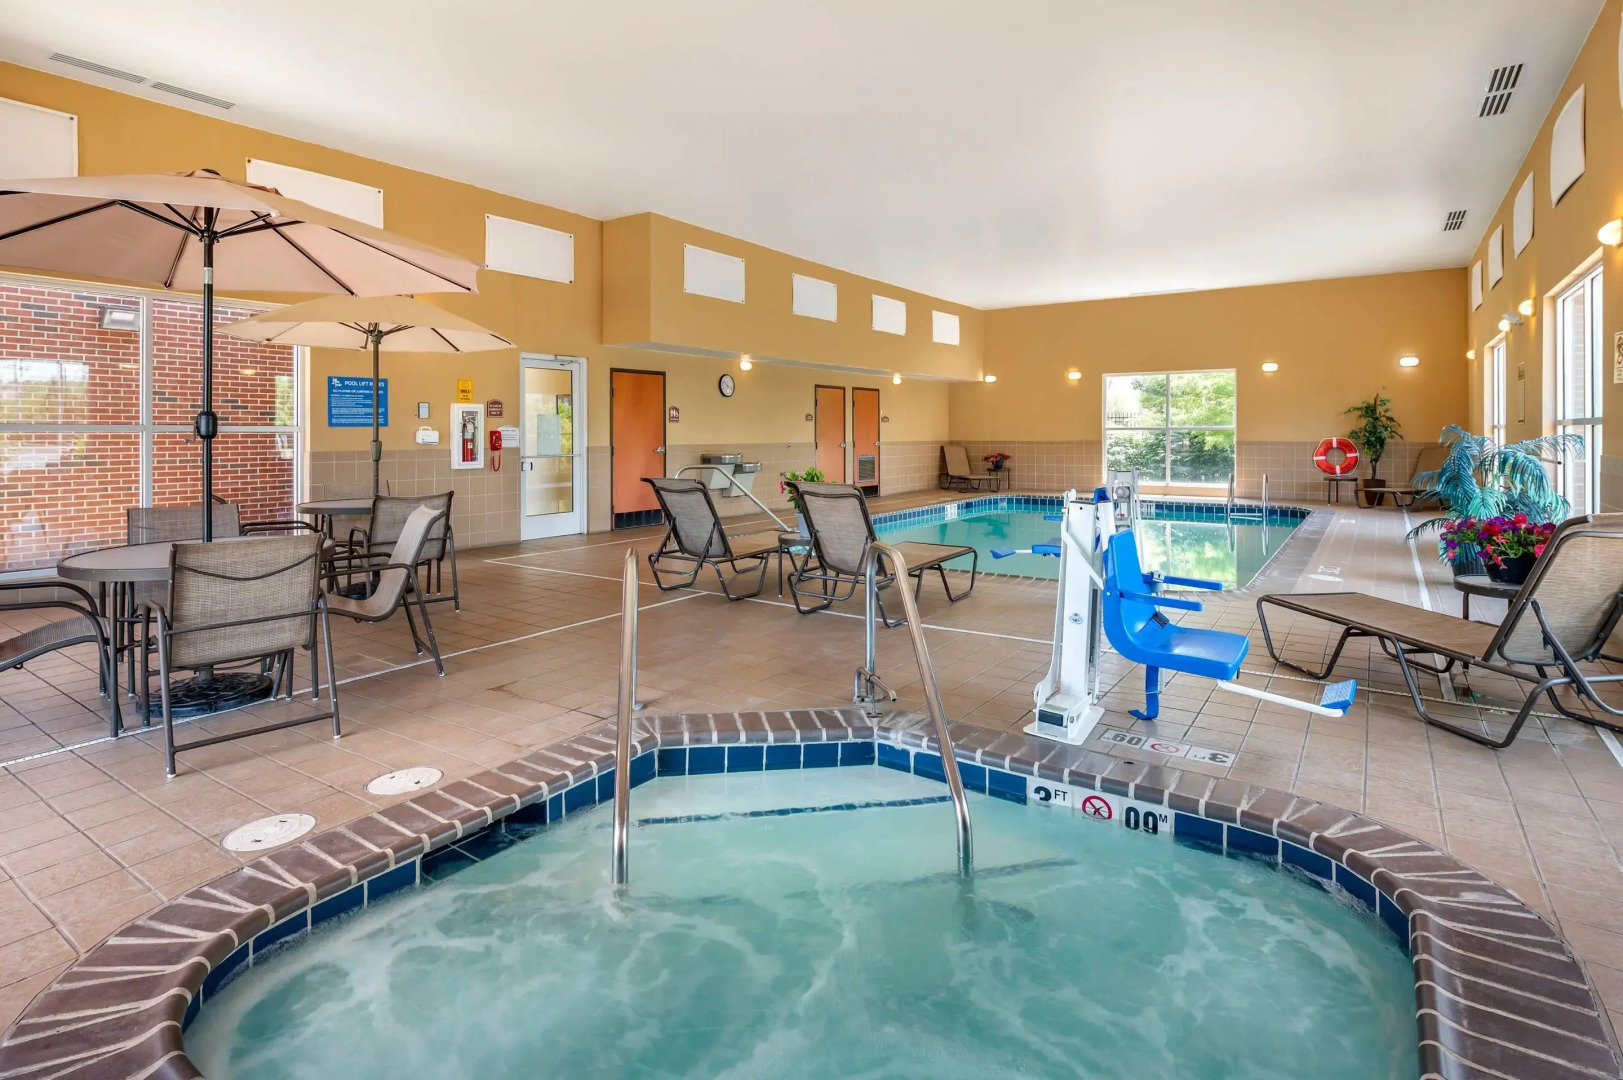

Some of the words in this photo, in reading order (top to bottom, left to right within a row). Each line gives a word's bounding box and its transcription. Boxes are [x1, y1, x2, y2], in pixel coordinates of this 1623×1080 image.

[1208, 752, 1230, 763] 3
[1054, 789, 1068, 802] FT
[1159, 814, 1168, 823] M
